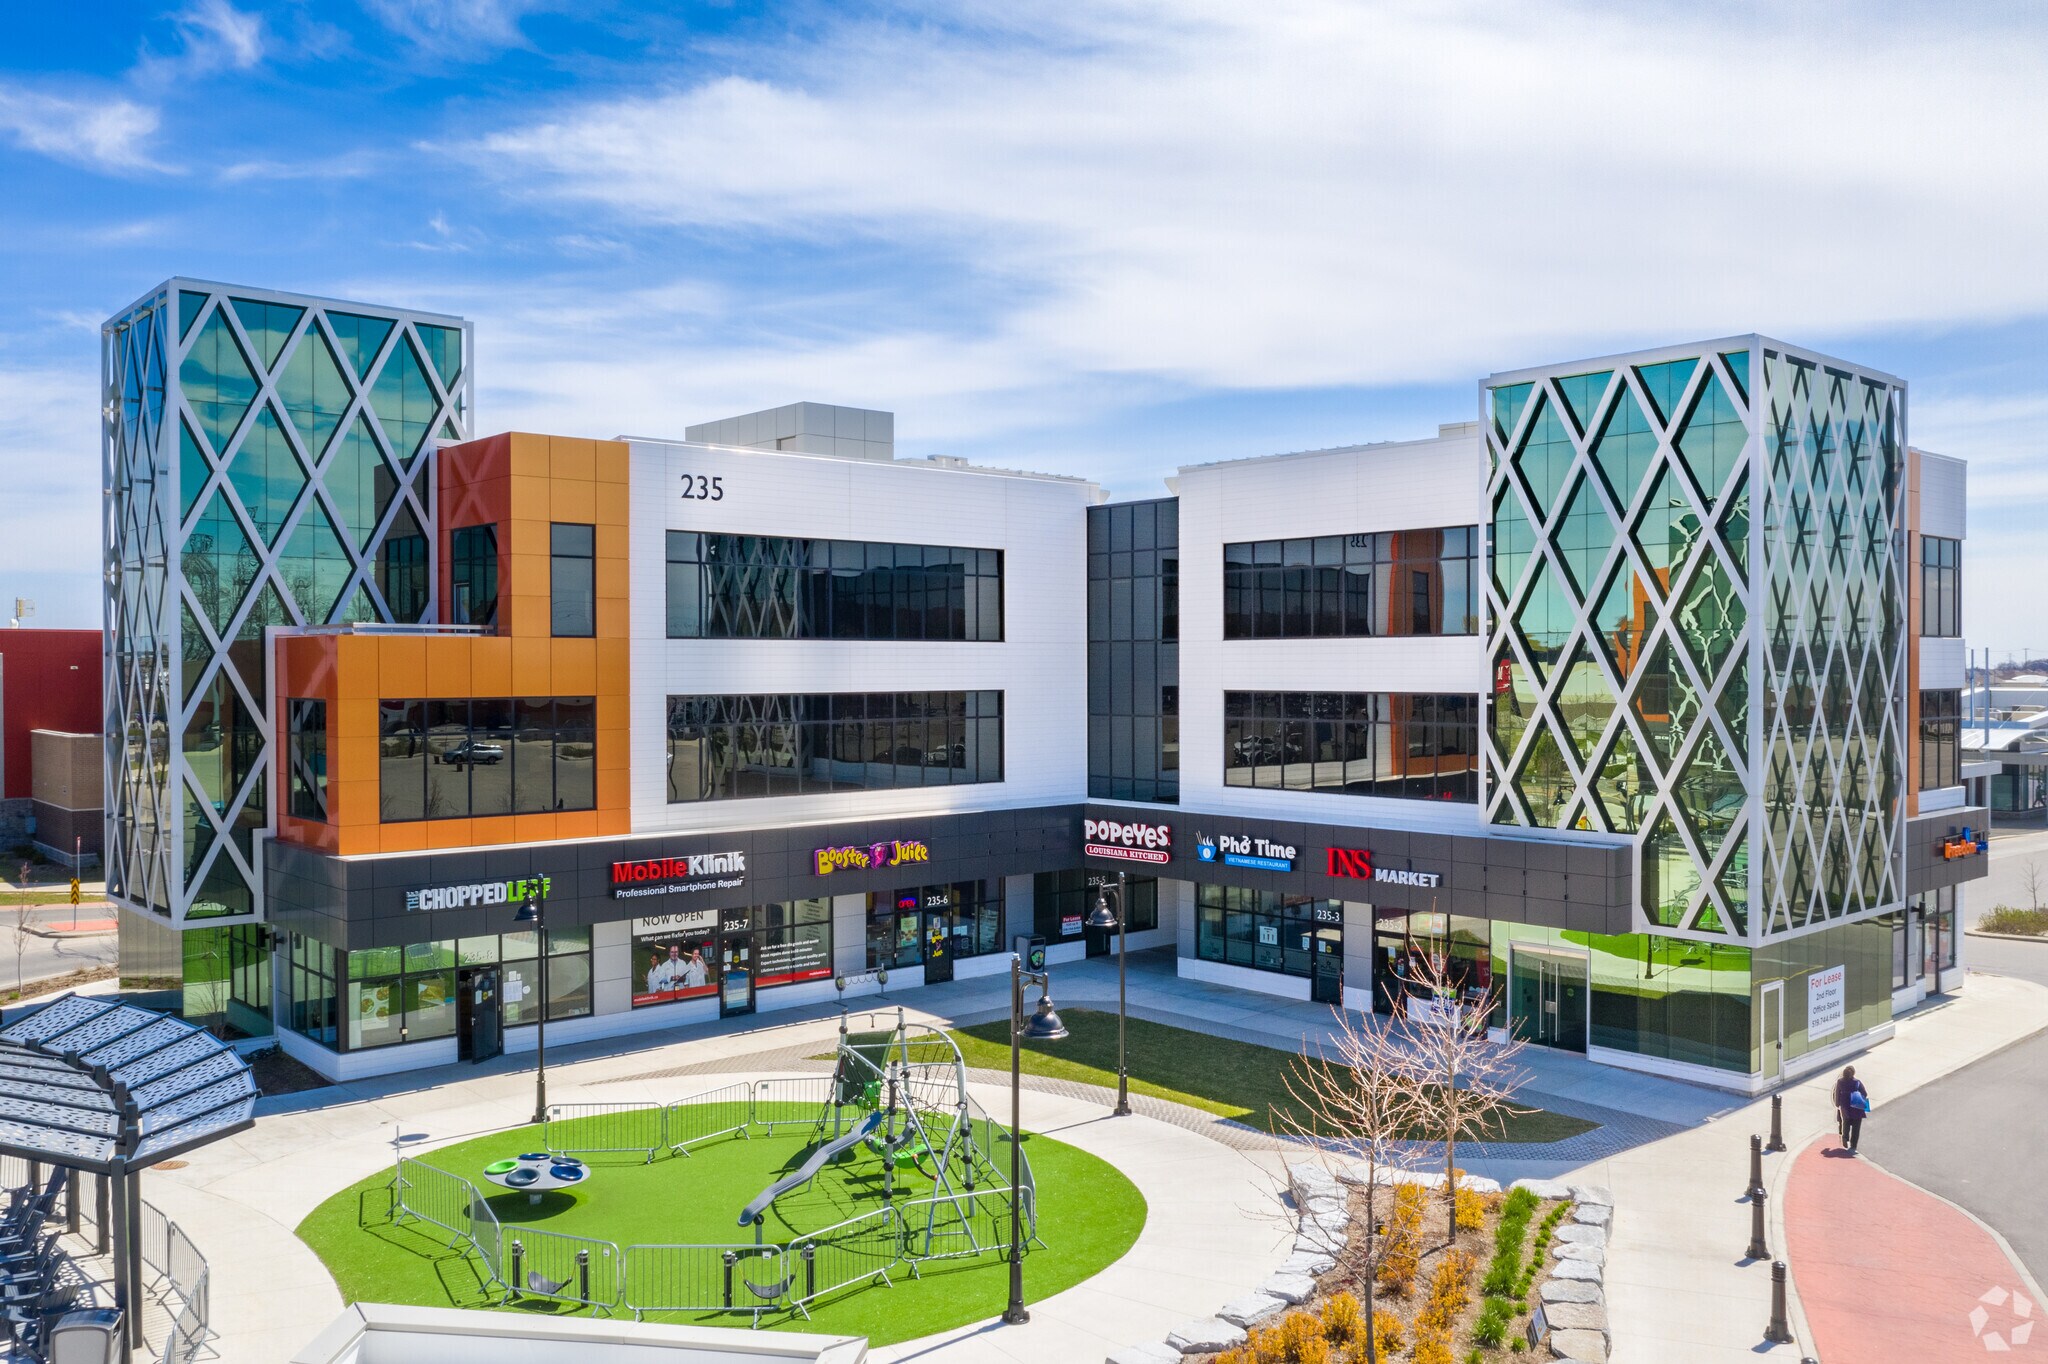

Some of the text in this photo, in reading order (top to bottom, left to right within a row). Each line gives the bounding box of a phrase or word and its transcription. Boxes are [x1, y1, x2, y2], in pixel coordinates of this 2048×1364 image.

[681, 474, 724, 501] 235
[1087, 845, 1165, 863] LOUISIANA KITCHEN
[1255, 838, 1296, 860] Time
[815, 840, 928, 876] Booster Juice
[1227, 857, 1289, 870] VIETNAMESE RESTAURANT
[1325, 846, 1440, 889] INS MARKET
[616, 877, 743, 899] Professional Smartphone Repair
[406, 891, 420, 911] THE
[898, 899, 916, 909] OPEN
[927, 895, 949, 906] 235-6
[642, 911, 704, 928] NOW OPEN
[1316, 910, 1341, 922] 235-3
[1378, 918, 1404, 931] 235-2
[724, 919, 749, 931] 235-7
[1811, 971, 1842, 990] For Lease
[1816, 988, 1837, 1001] 2nd Floor
[1813, 1000, 1840, 1014] Office Space
